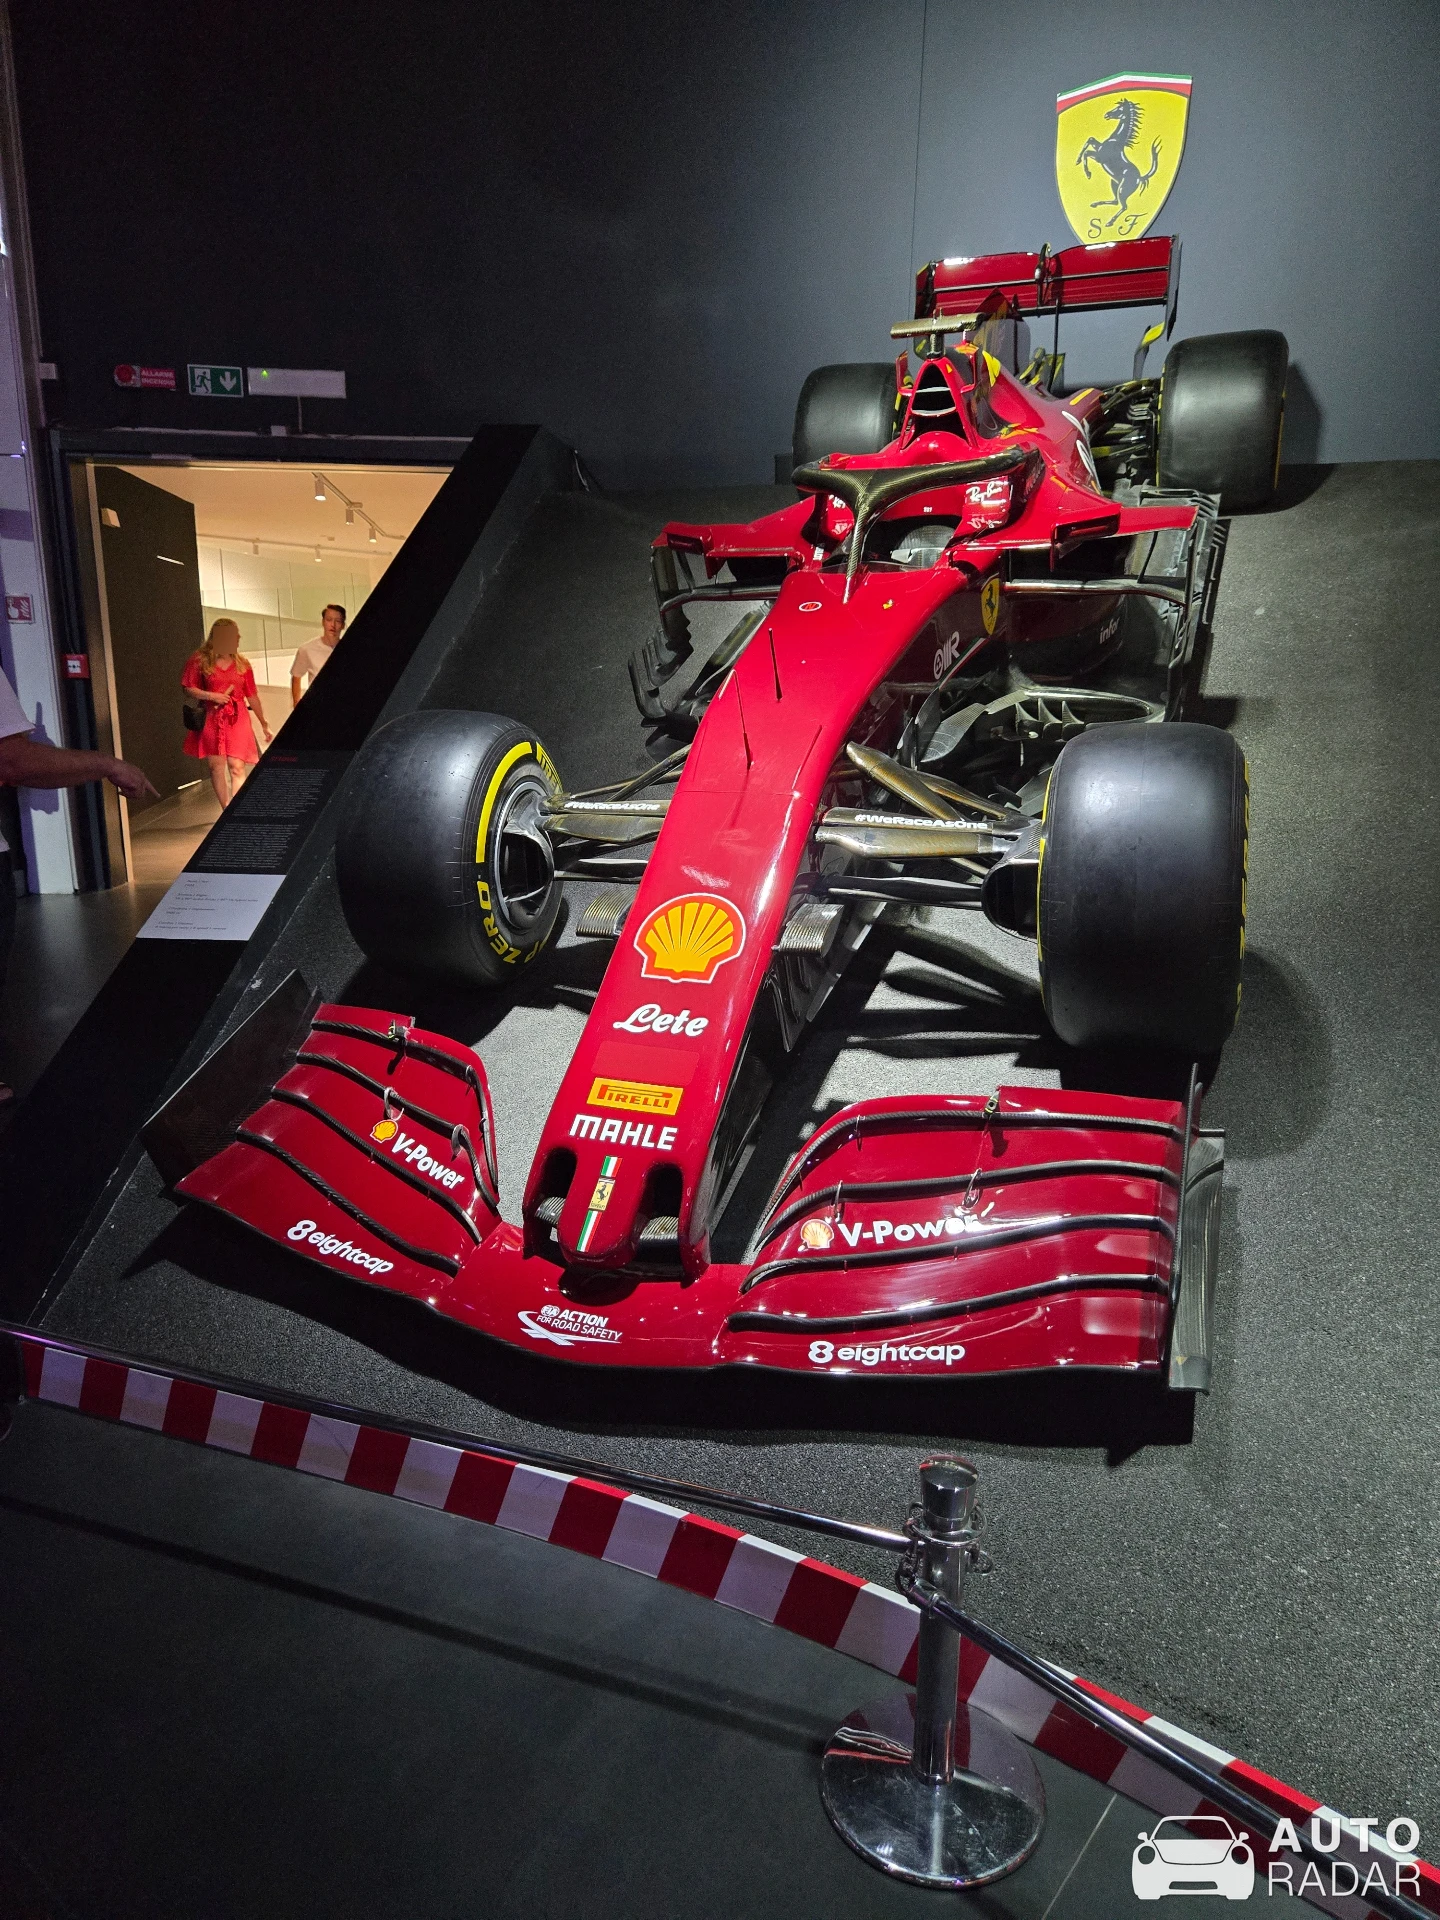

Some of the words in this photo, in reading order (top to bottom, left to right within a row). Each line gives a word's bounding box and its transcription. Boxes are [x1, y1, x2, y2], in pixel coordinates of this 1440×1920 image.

[1087, 218, 1102, 239] S
[1117, 212, 1148, 236] F
[854, 814, 989, 830] #WeRaceAsOne
[476, 880, 522, 965] ZERO
[612, 1003, 710, 1037] Lete
[596, 1084, 674, 1109] PIRELLI
[569, 1113, 679, 1150] MAHLE
[391, 1132, 465, 1189] V-Power
[837, 1213, 981, 1247] V-Power
[308, 1233, 394, 1275] eightcap
[536, 1314, 552, 1324] FOR
[551, 1318, 581, 1333] ROAD
[580, 1324, 623, 1341] SAFETY
[558, 1309, 609, 1328] ACTION
[837, 1342, 966, 1366] eightcap
